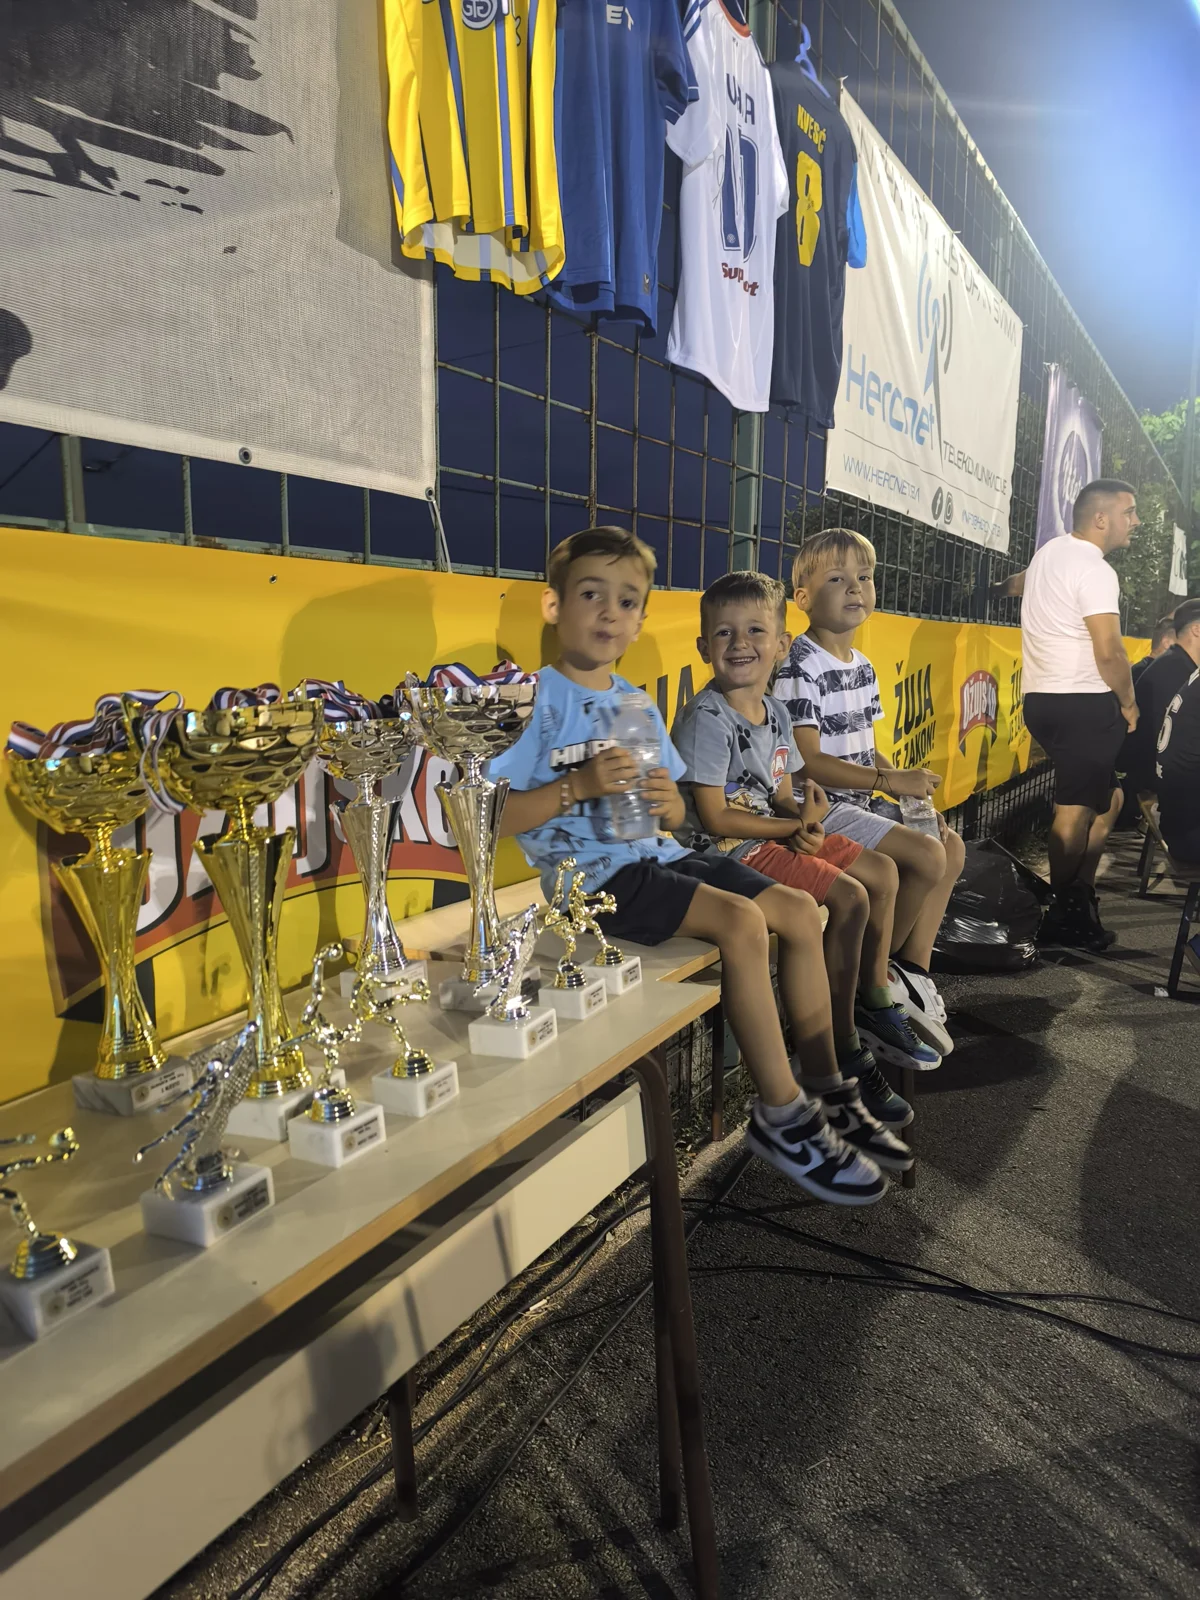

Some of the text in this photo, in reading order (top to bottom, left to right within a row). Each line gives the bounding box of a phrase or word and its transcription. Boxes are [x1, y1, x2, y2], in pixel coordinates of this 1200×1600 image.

[796, 150, 823, 267] 8
[845, 343, 935, 451] Hercnet
[893, 660, 934, 745] ŽUJA
[903, 720, 936, 770] ZAKON!
